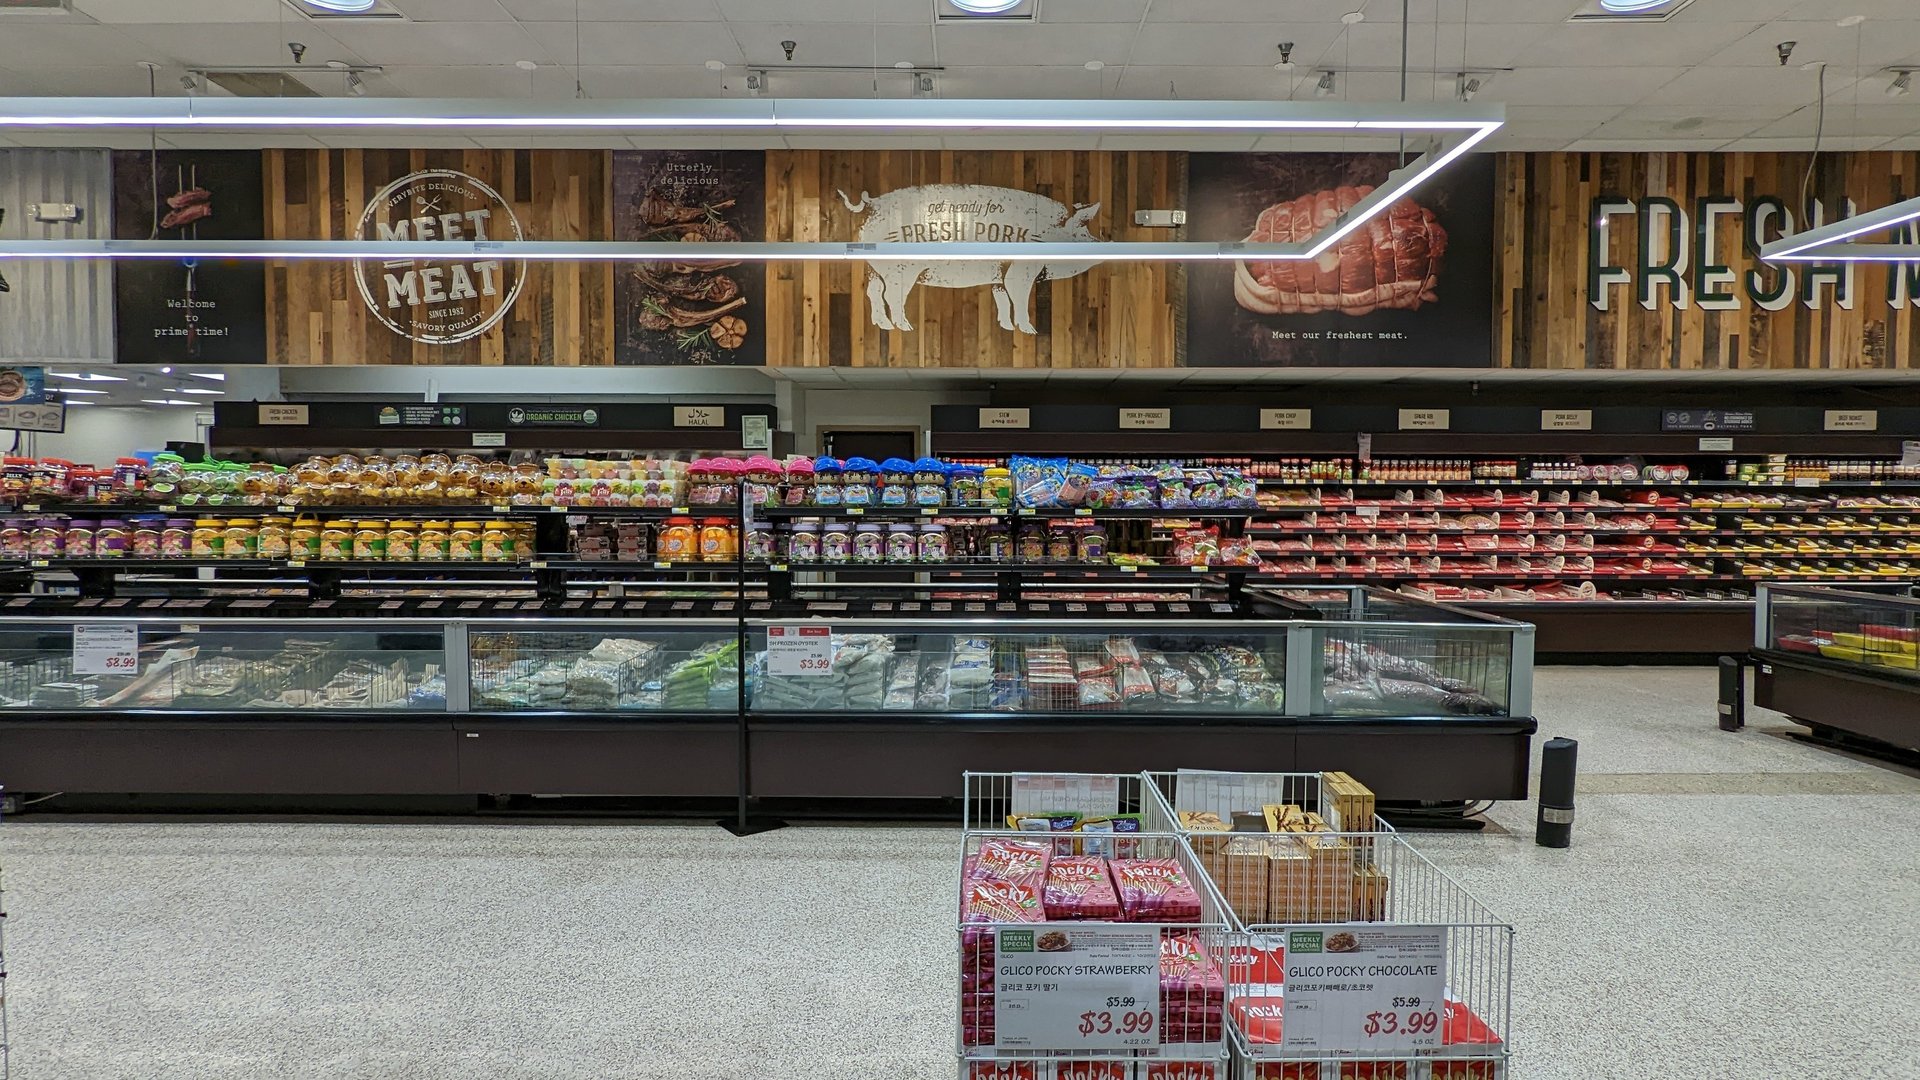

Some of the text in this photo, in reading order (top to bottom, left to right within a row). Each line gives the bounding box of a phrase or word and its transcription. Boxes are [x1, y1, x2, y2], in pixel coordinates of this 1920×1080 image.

[666, 163, 712, 173] Utterly
[661, 176, 719, 185] delicious
[429, 183, 475, 200] DELICIOUS
[928, 200, 945, 216] get
[983, 199, 1005, 216] for
[377, 209, 491, 241] MEET
[901, 222, 1029, 242] FRESH PORK
[1590, 197, 1856, 311] FRESH
[384, 261, 498, 309] MEAT
[167, 299, 216, 308] Welcome
[428, 307, 465, 319] SINCE 1982
[411, 311, 483, 332] SAVORY QUALITY
[154, 327, 229, 338] prime time!
[1272, 331, 1296, 339] Meet
[1326, 331, 1373, 339] freshest
[1379, 331, 1408, 339] meat.
[105, 657, 136, 668] $8.99
[800, 658, 830, 670] $3.99
[1001, 965, 1154, 976] GLICO POCKY STRAWBERRY
[1289, 965, 1438, 977] GLICO POCKY CHOCOLATE
[1000, 983, 1058, 992] 글리코 포키 딸기
[1106, 996, 1135, 1008] $5.99
[1392, 997, 1420, 1010] $5.99
[1078, 1010, 1153, 1038] $3.99
[1364, 1010, 1438, 1038] $3.99
